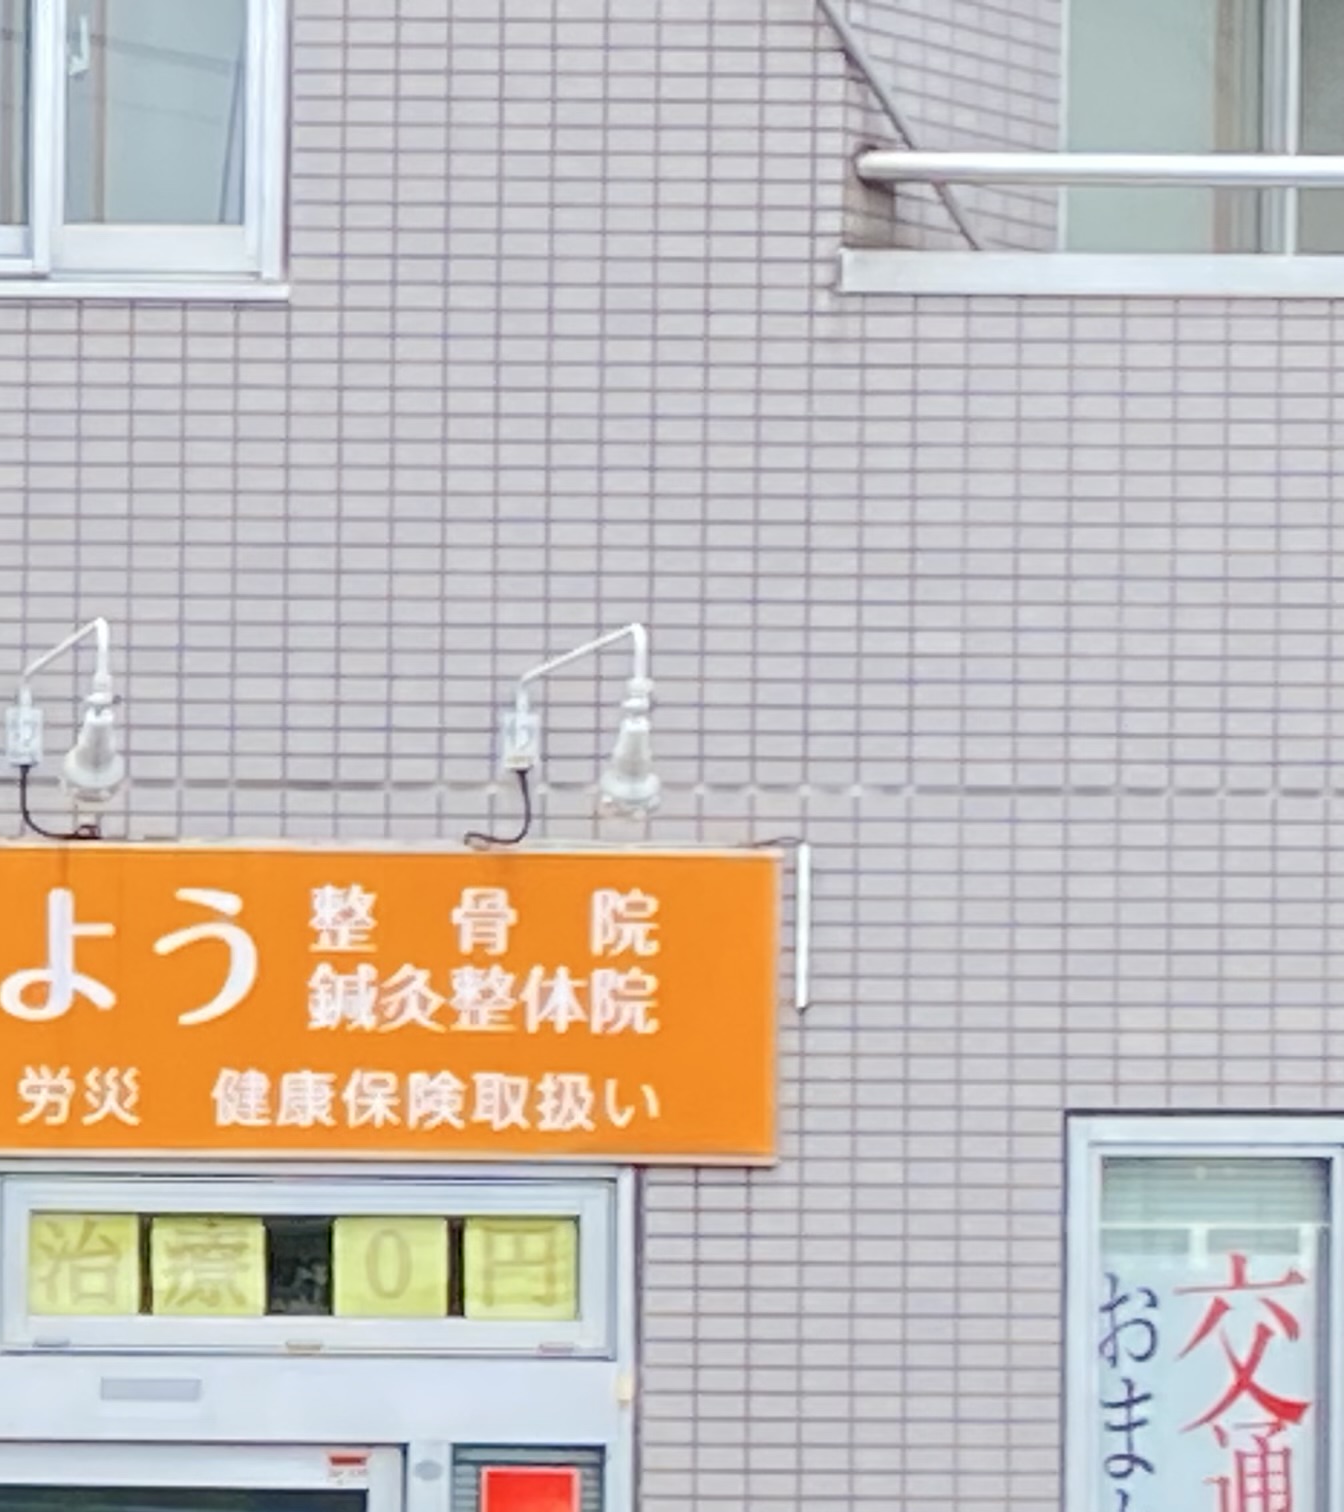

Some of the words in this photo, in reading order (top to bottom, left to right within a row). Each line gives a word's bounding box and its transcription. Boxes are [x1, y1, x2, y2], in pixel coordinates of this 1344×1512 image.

[309, 884, 660, 957] 整骨院
[307, 962, 660, 1034] 鍼灸整体院
[17, 1064, 141, 1126] 労災
[211, 1067, 660, 1132] 健康保険取扱い
